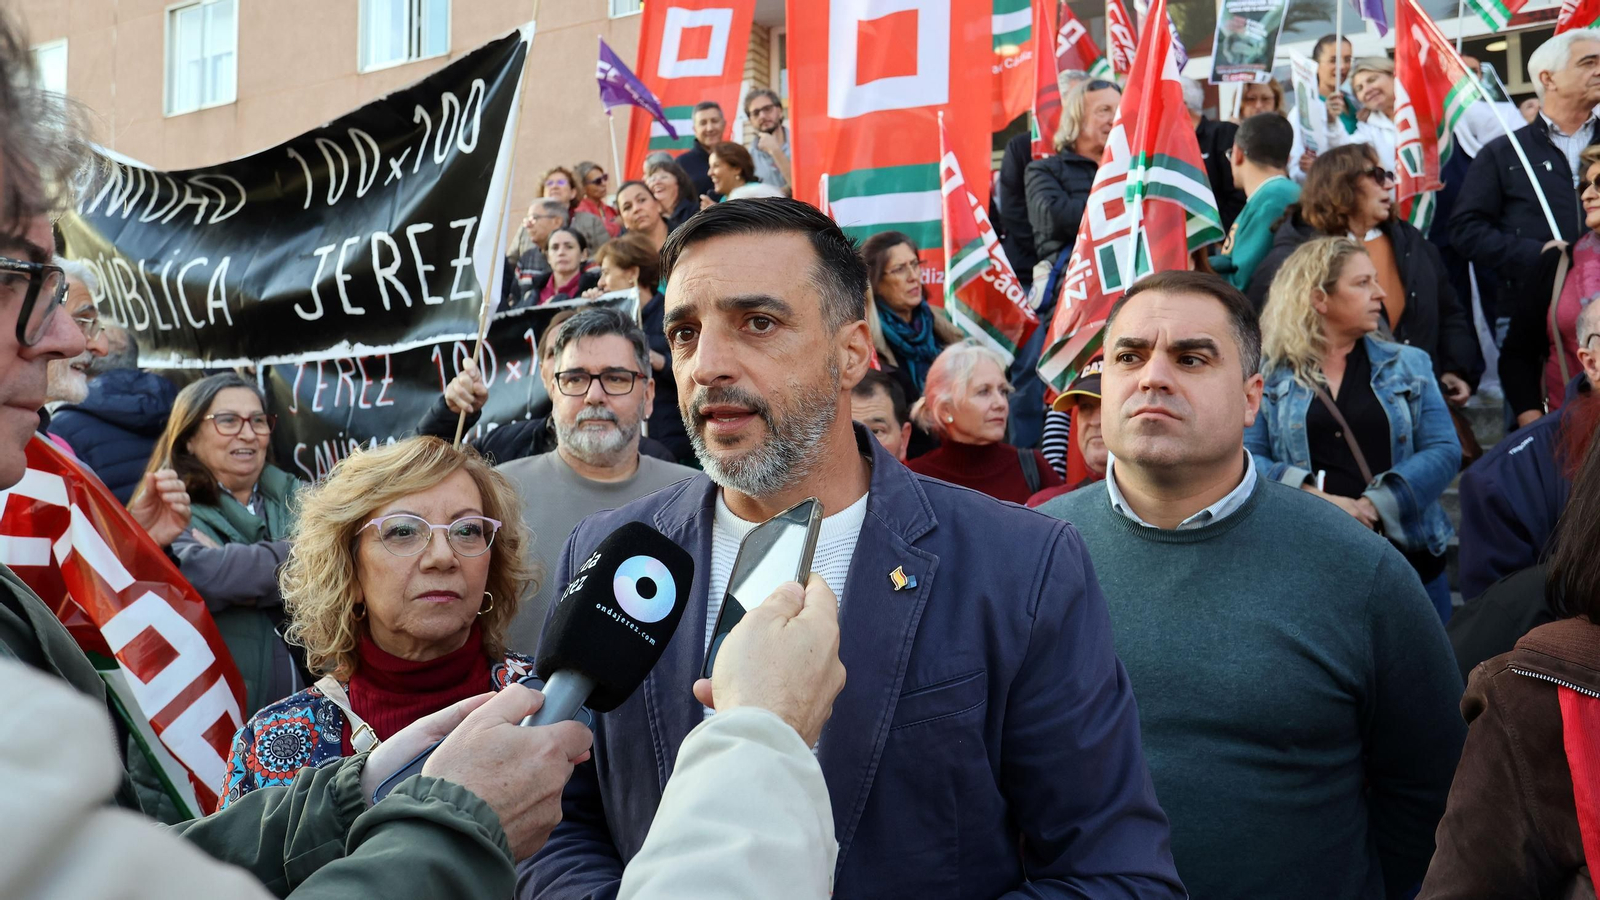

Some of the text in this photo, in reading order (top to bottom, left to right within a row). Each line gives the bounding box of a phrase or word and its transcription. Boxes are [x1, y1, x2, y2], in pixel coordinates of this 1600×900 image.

[294, 216, 478, 321] JEREZ
[981, 258, 1036, 320] Cádiz
[1065, 240, 1092, 309] diz
[289, 353, 394, 414] JEREZ
[595, 603, 656, 646] ondajerez.com
